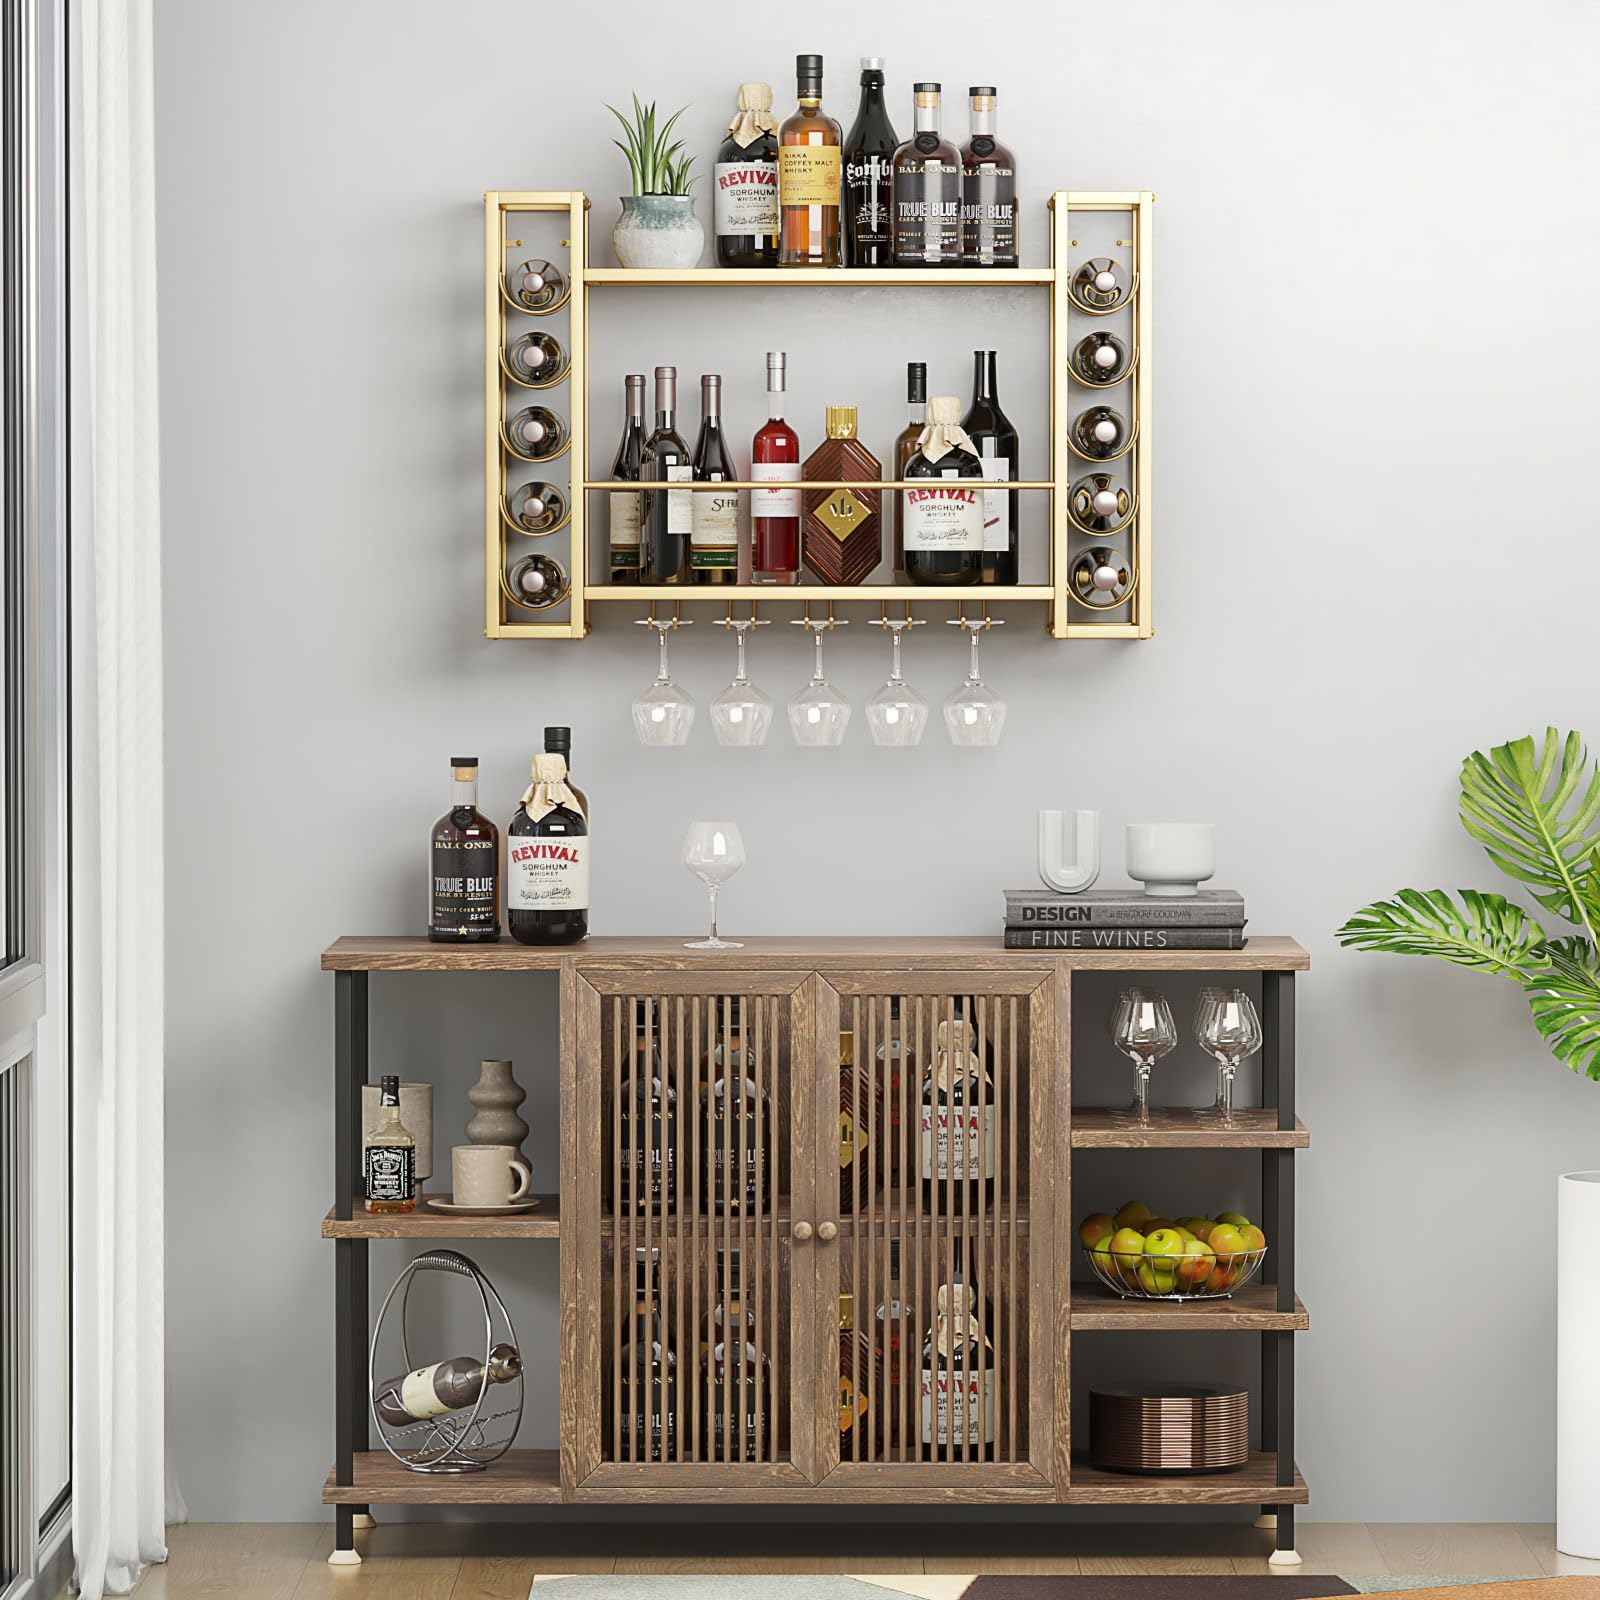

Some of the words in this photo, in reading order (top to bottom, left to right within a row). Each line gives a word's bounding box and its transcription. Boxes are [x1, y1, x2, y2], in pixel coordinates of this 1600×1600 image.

[899, 166, 957, 174] BALCONES
[719, 170, 777, 190] REVIVA
[730, 189, 775, 197] SORGHUM
[898, 202, 928, 217] TRUE
[931, 202, 957, 217] BLUE
[961, 204, 983, 219] RUE
[987, 204, 1013, 219] BLUE
[907, 488, 976, 504] REVIVAL
[435, 841, 493, 849] BALCONES
[511, 845, 579, 863] REVIVAL
[434, 877, 464, 892] TRUE
[466, 877, 493, 892] BLUE
[1022, 907, 1091, 921] DESIGN
[1032, 930, 1082, 946] FINE
[1092, 930, 1167, 947] WINES
